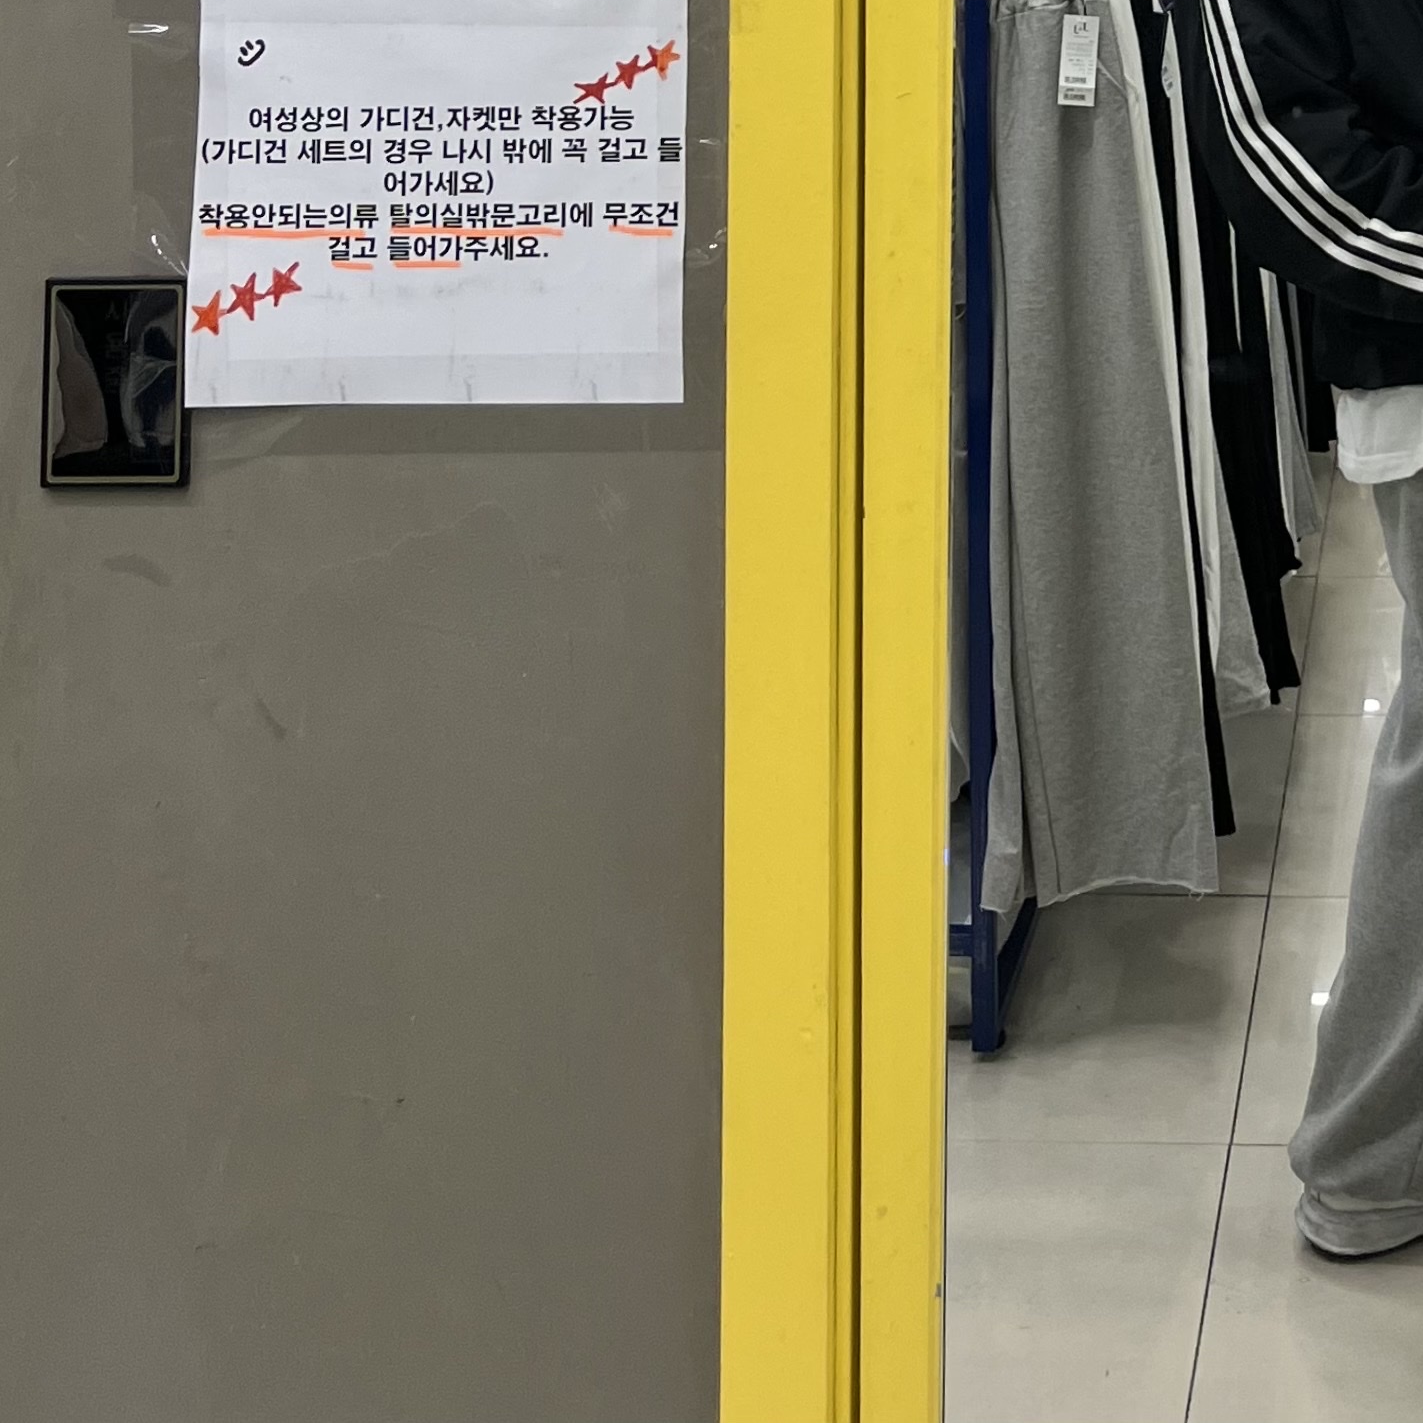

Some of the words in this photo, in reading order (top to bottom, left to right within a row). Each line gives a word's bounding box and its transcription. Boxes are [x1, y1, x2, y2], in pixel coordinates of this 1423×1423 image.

[250, 107, 348, 132] 여성상의
[360, 106, 522, 131] 가디건,자켓만
[532, 106, 634, 131] 착용가능
[202, 139, 286, 164] (가디건
[298, 139, 371, 164] 세트의
[384, 139, 432, 164] 경우
[443, 139, 490, 163] 나시
[504, 139, 551, 163] 밖에
[562, 139, 587, 162] 꼭
[599, 138, 647, 162] 걸고
[658, 138, 682, 162] 들
[384, 170, 493, 196] 어가세요)
[199, 204, 379, 229] 착용안되는의류
[390, 202, 592, 228] 탈의실밖문고리에
[603, 202, 678, 226] 무조건
[329, 236, 377, 261] 걸고
[387, 236, 548, 261] 들어가주세요.
